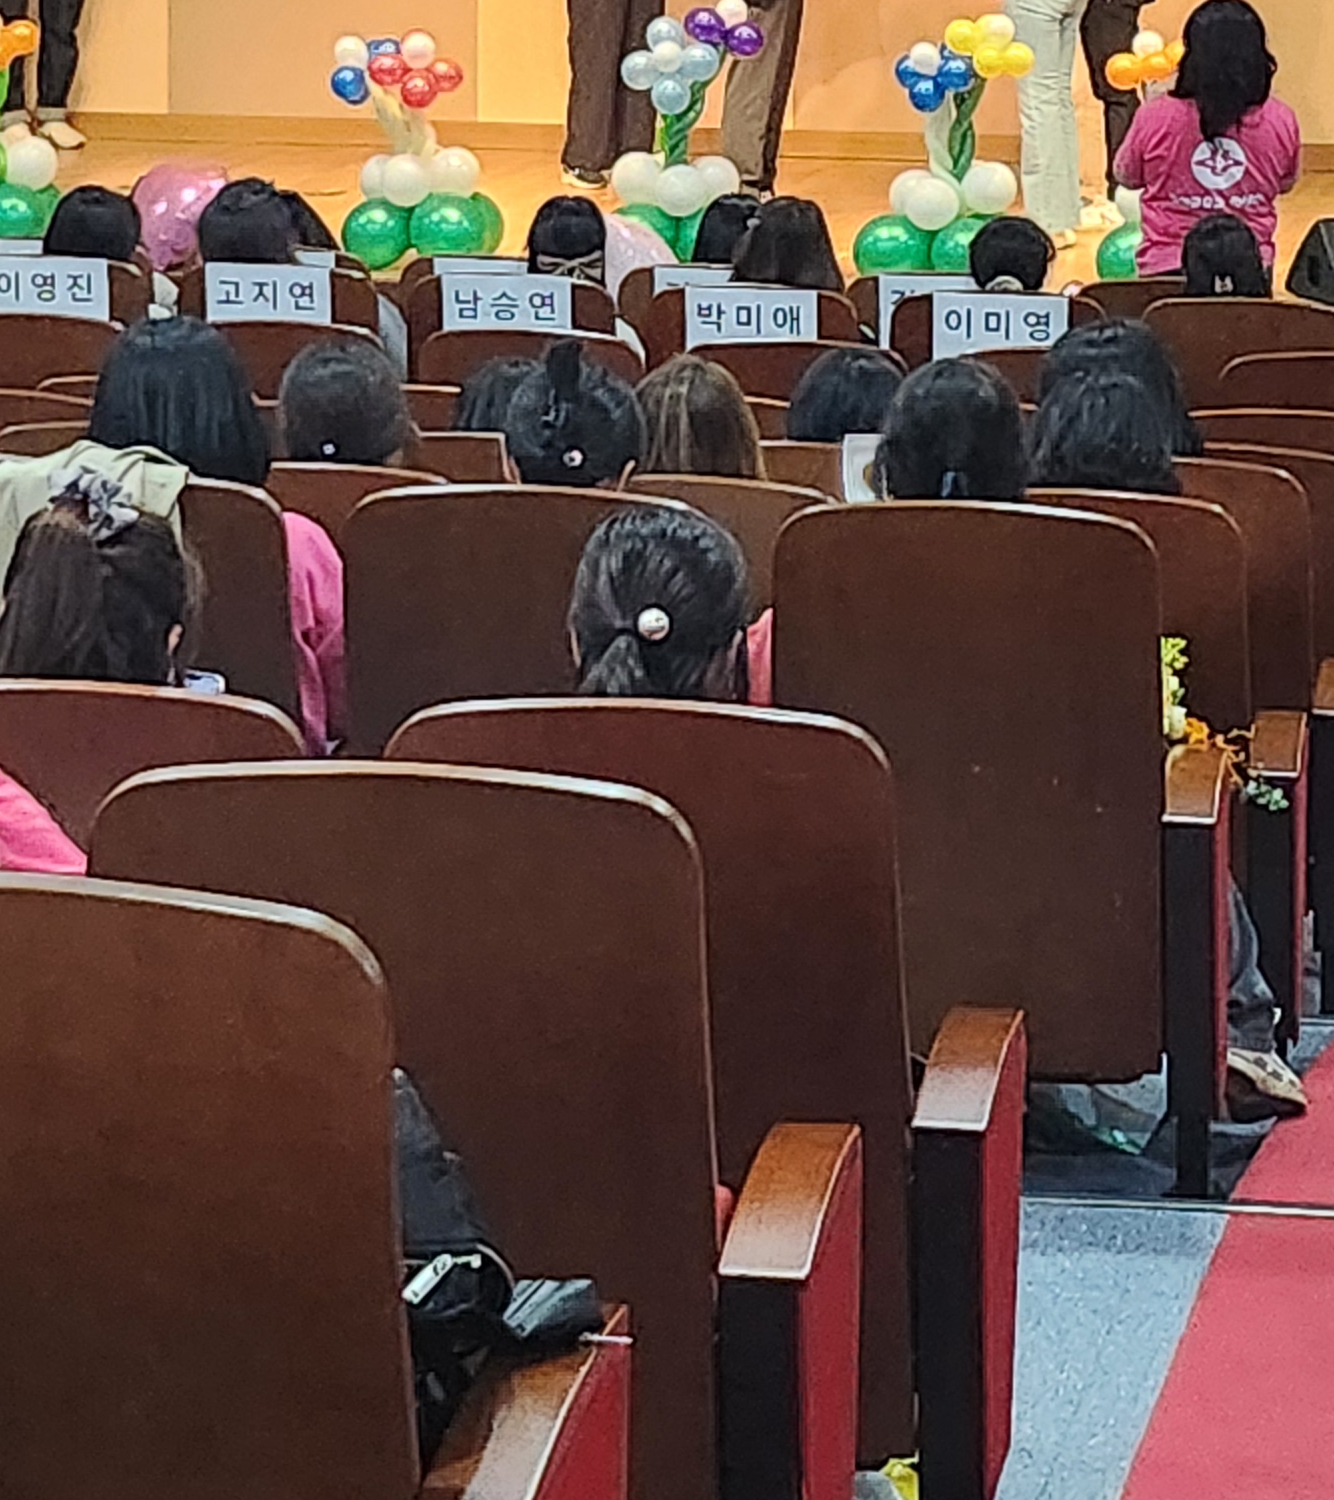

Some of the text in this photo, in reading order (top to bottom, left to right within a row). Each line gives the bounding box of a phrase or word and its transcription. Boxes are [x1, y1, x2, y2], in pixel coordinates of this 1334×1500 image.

[216, 279, 317, 312] 고지연
[453, 289, 559, 323] 남승연
[696, 303, 802, 337] 박미애
[943, 307, 1053, 342] 이미영
